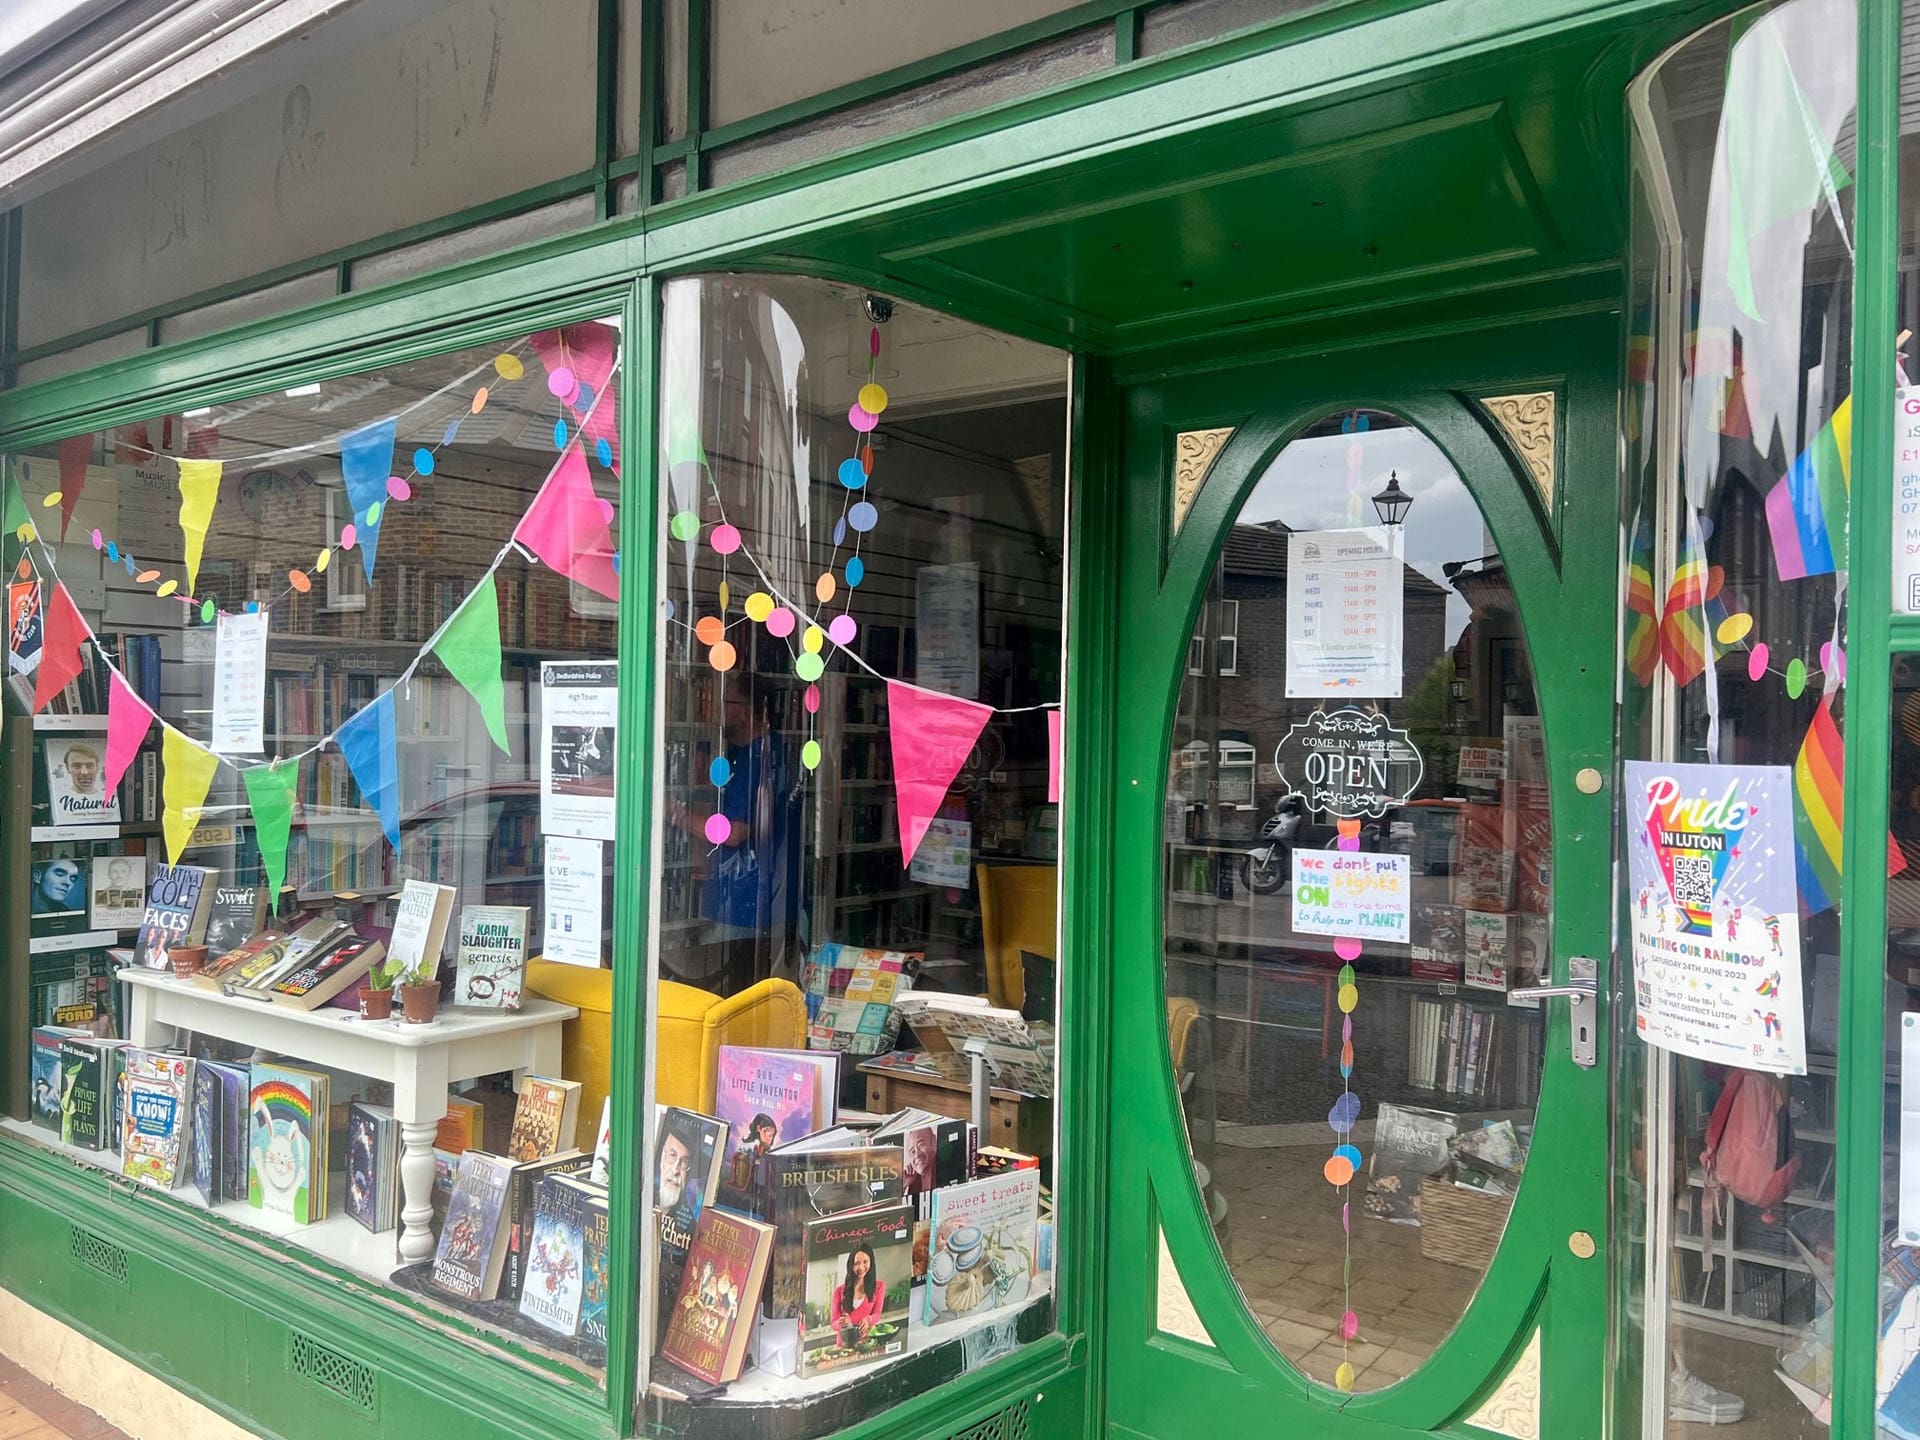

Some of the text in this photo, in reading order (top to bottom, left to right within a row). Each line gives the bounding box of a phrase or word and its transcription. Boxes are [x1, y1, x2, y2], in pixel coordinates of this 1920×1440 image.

[135, 470, 166, 481] Music
[1337, 545, 1384, 557] OPENING HOURS
[556, 672, 585, 680] Bedfordshire
[568, 693, 598, 703] High Town
[1302, 737, 1335, 748] COME
[1357, 740, 1395, 752] WE'RE
[1305, 752, 1390, 790] OPEN
[1645, 776, 1749, 831] Pride
[1661, 832, 1723, 850] IN LUTON
[1301, 856, 1398, 873] we dont put
[1300, 871, 1329, 885] the
[150, 878, 201, 910] COLE
[215, 888, 257, 906] Swift
[1297, 884, 1330, 907] ON
[1353, 901, 1372, 910] the
[1375, 903, 1402, 911] time
[143, 907, 190, 932] FACES
[1299, 909, 1405, 929] to help our PLANET
[476, 923, 510, 937] KARIN
[461, 935, 522, 950] SLAUGHTER
[1639, 932, 1766, 968] PAINTING OUR RAINBOW
[468, 952, 513, 966] genesis
[1651, 955, 1748, 981] SATURDAY 24TH JUNE 2023
[56, 1010, 94, 1023] FORD
[1658, 997, 1737, 1021] THE HAT DISTRICT LUTON
[74, 1086, 97, 1102] PRIVATE
[731, 1077, 799, 1101] LITTLE INVENTOR
[77, 1099, 93, 1115] LIFE
[136, 1101, 171, 1123] KNOW!
[73, 1119, 96, 1136] PLANTS
[1395, 1125, 1439, 1146] FRANCE
[472, 1158, 495, 1182] TERRY
[781, 1166, 899, 1189] BRITISH ISLES
[947, 1190, 987, 1212] sweet
[991, 1179, 1034, 1201] treats
[712, 1219, 741, 1243] TERRY
[815, 1215, 907, 1244] Chinese Food
[432, 1256, 482, 1288] MONSTROUS
[433, 1269, 475, 1297] REGIMENT
